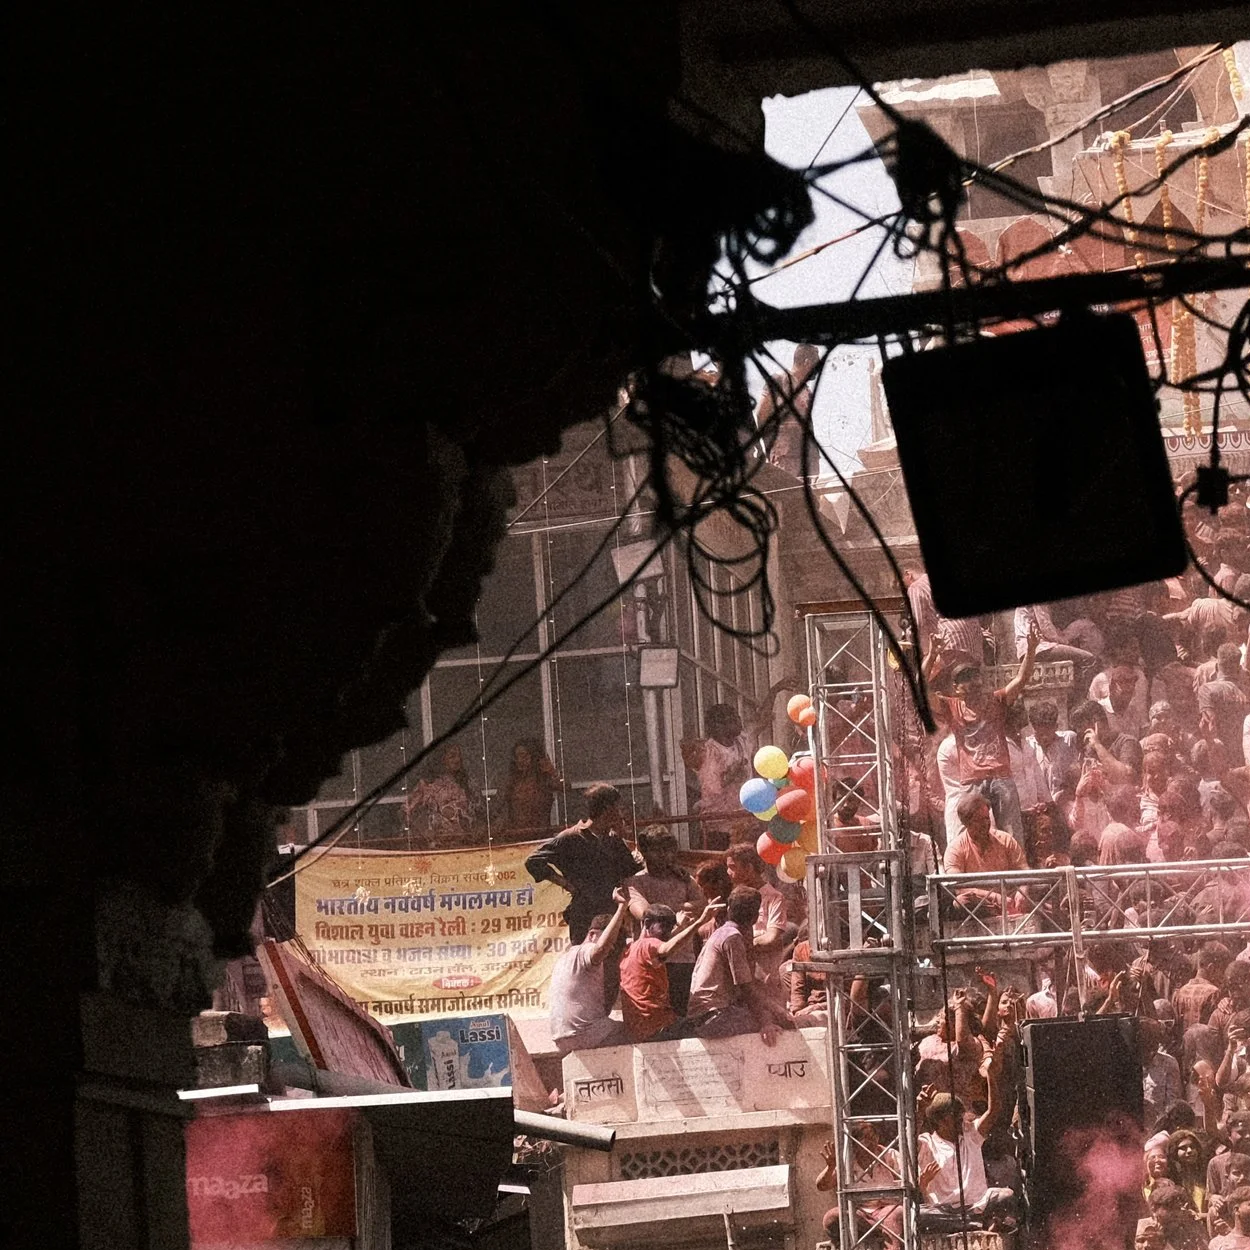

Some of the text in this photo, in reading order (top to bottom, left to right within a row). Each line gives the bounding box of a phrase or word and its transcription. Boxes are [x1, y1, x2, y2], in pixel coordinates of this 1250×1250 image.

[384, 888, 436, 914] नववर्ष
[440, 888, 512, 912] मंगलमय
[516, 882, 535, 906] हो
[314, 920, 364, 941] विशाल
[367, 922, 395, 946] युवा
[399, 921, 435, 940] वाहन
[434, 914, 467, 938] रैली
[480, 917, 502, 935] 29
[504, 910, 533, 932] मार्च
[382, 948, 393, 963] व
[396, 946, 433, 962] भजन
[486, 941, 508, 958] 30
[511, 934, 540, 956] मार्च
[359, 967, 398, 979] स्थान
[409, 966, 444, 976] टाउन
[372, 992, 416, 1016] नववर्ष
[417, 990, 494, 1015] समाजोत्सव
[495, 987, 547, 1009] समिति,
[459, 1025, 502, 1044] Lassi
[301, 1186, 315, 1230] maaza
